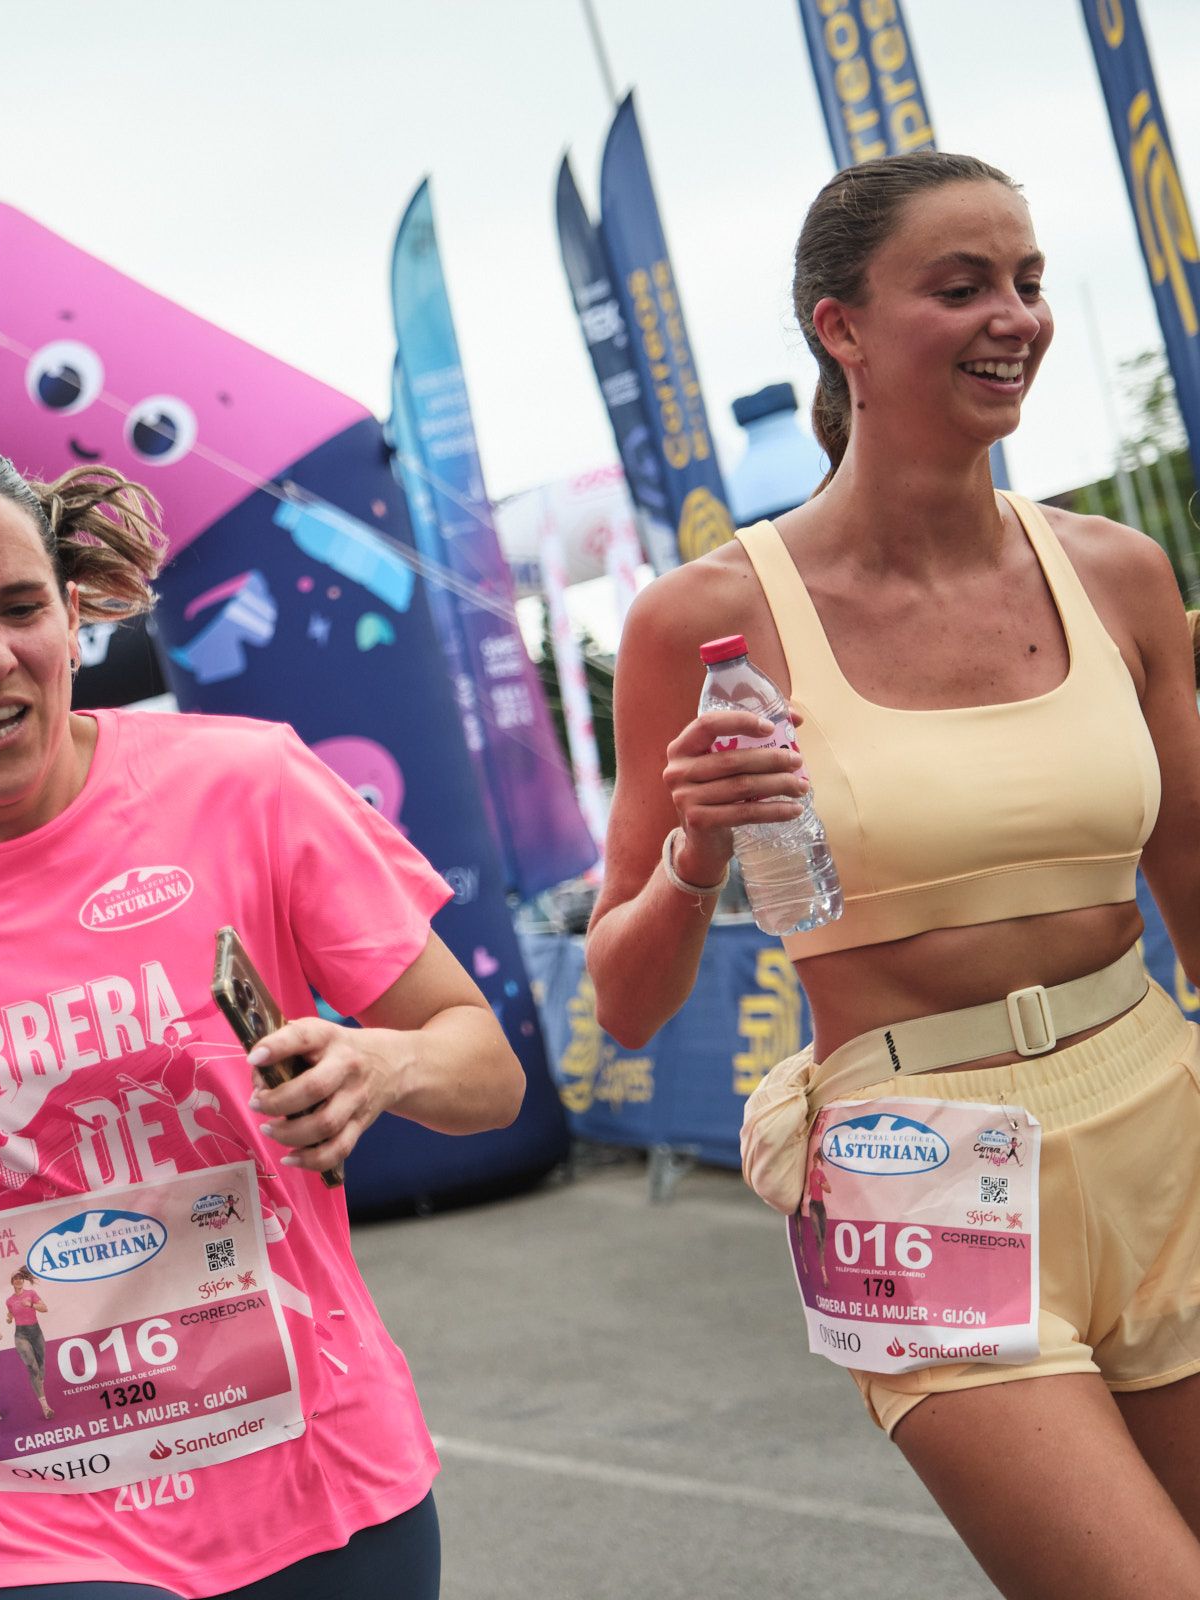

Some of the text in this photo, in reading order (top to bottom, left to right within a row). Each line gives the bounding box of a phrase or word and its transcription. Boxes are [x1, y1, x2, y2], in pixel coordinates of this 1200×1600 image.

[90, 880, 187, 926] ASTURIANA
[884, 1031, 901, 1072] RIPRUN
[66, 1087, 179, 1192] DE
[828, 1134, 938, 1162] ASTURIANA
[848, 1133, 888, 1141] CENTRAL
[974, 1143, 1000, 1153] Carrera
[988, 1152, 1008, 1166] Mujer
[190, 1211, 219, 1222] Carrera
[209, 1217, 228, 1230] Mujer
[967, 1210, 1001, 1225] gijón
[57, 1223, 152, 1248] CENTRAL LECHERA
[834, 1222, 932, 1269] 016
[942, 1233, 1025, 1248] CORREDORA
[39, 1233, 160, 1272] ASTURIANA
[198, 1277, 235, 1299] gijón
[864, 1278, 895, 1297] 179
[180, 1298, 266, 1326] CORREDORA
[850, 1301, 862, 1316] DE
[865, 1304, 878, 1318] LA
[883, 1304, 928, 1320] MUJER
[943, 1306, 986, 1325] GIJÓN
[57, 1318, 179, 1385] 016
[909, 1342, 999, 1358] Santander
[63, 1364, 177, 1396] TELÉFONO VIOLENCIA DE GÉNERO
[100, 1380, 156, 1409] 1320
[14, 1384, 247, 1452] CARRERA DE LA MUJER GIJÓN
[174, 1417, 265, 1455] Santander
[11, 1453, 111, 1481] OYSHO
